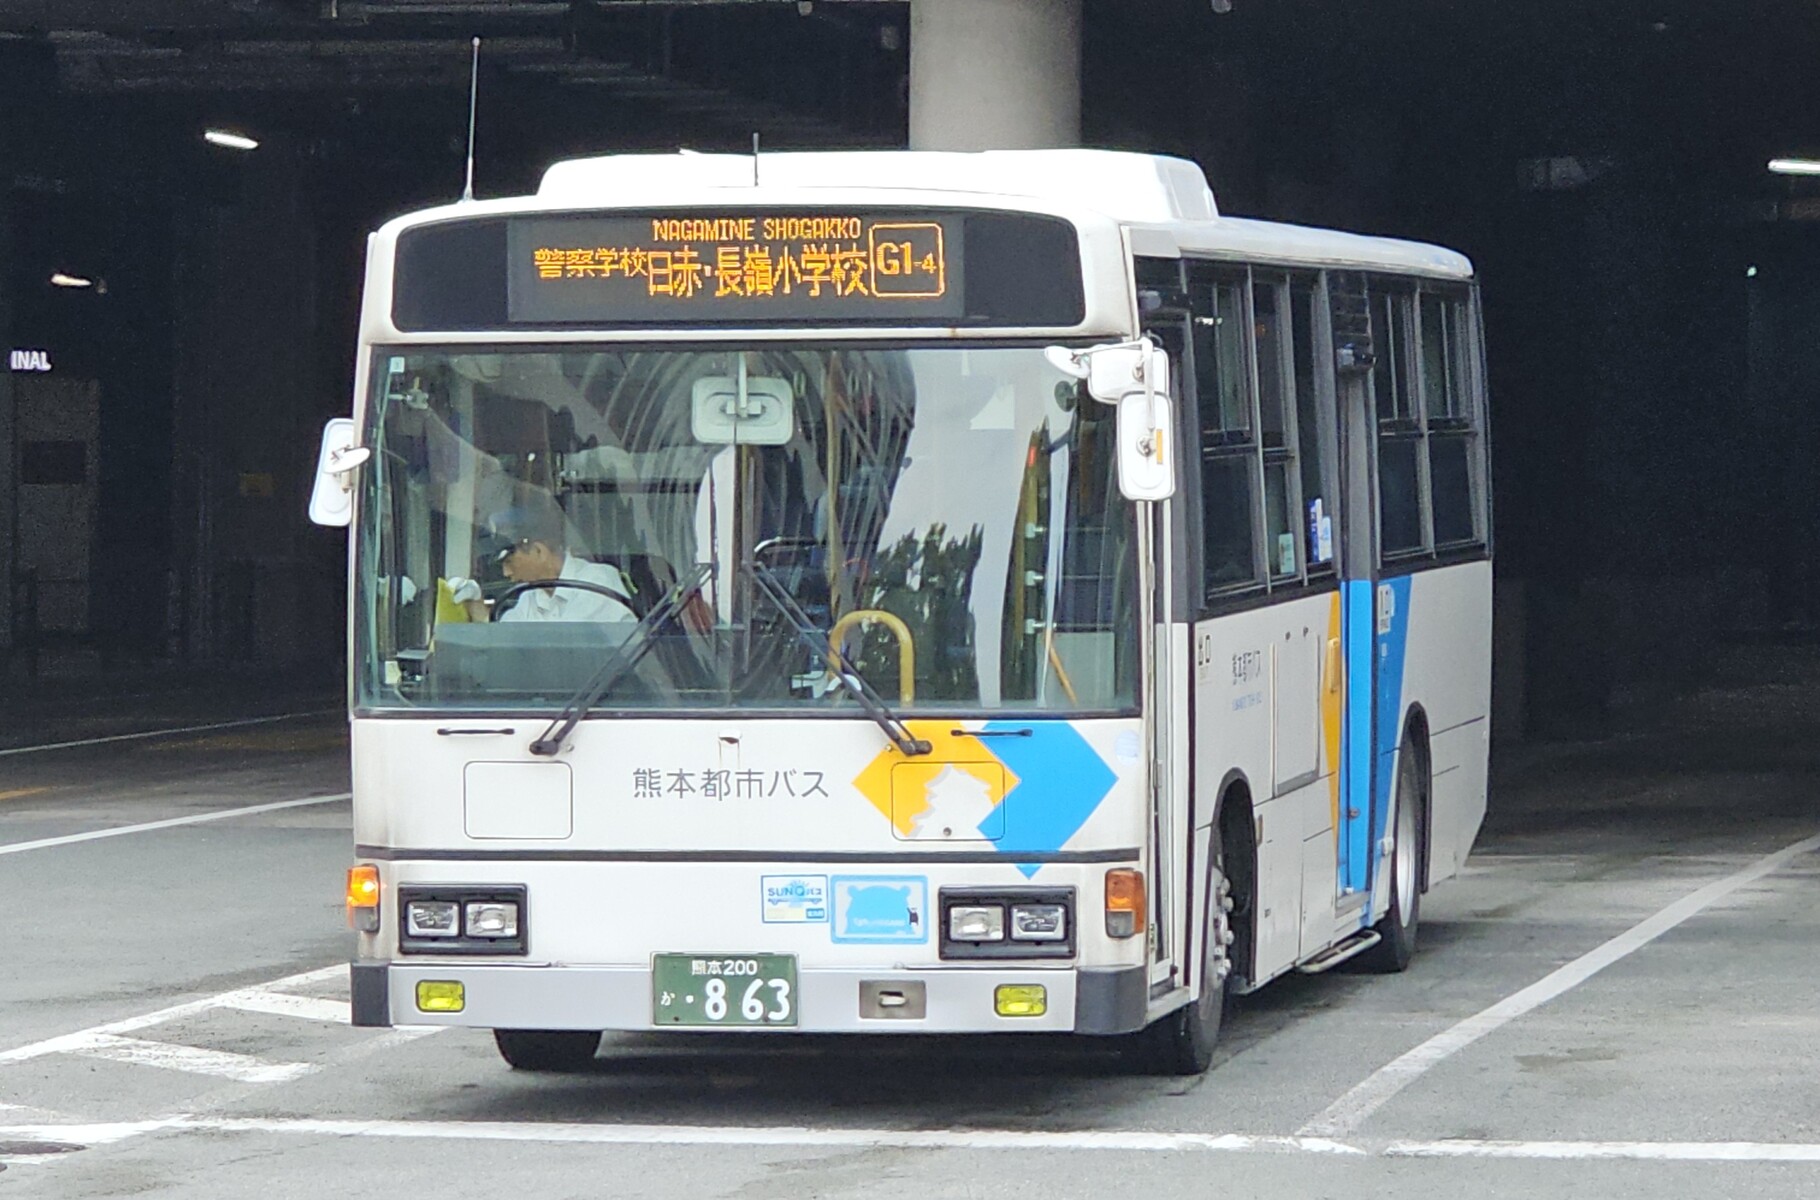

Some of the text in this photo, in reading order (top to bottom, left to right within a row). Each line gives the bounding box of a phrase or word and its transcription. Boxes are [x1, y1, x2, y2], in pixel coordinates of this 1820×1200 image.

[652, 217, 861, 241] NAGAMINE SHOGAKKO
[633, 768, 829, 801] 熊本都市バス
